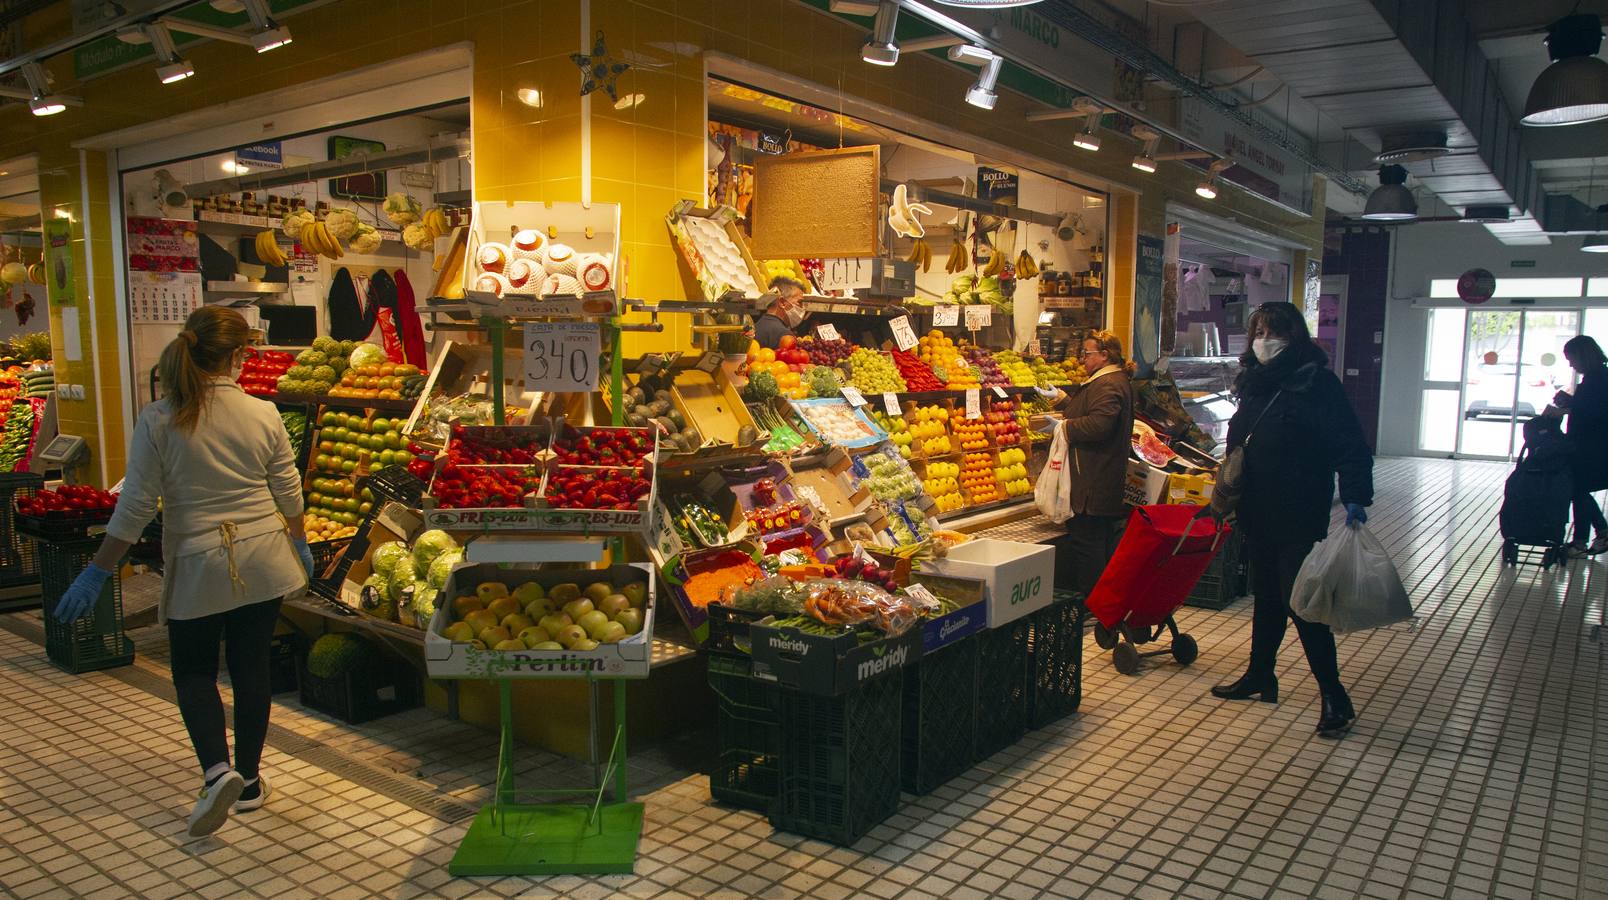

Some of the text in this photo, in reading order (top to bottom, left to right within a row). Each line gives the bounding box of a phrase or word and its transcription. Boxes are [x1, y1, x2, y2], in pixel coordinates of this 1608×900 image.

[1010, 7, 1059, 49] MARCO
[763, 140, 783, 153] BOLLO
[983, 172, 1009, 182] BOLLO
[459, 511, 528, 523] FRES-LUZ
[574, 512, 640, 525] FRES-LUZ
[1011, 575, 1041, 605] aura
[769, 636, 810, 655] meridy
[511, 653, 606, 673] Perlim
[857, 644, 909, 681] meridy
